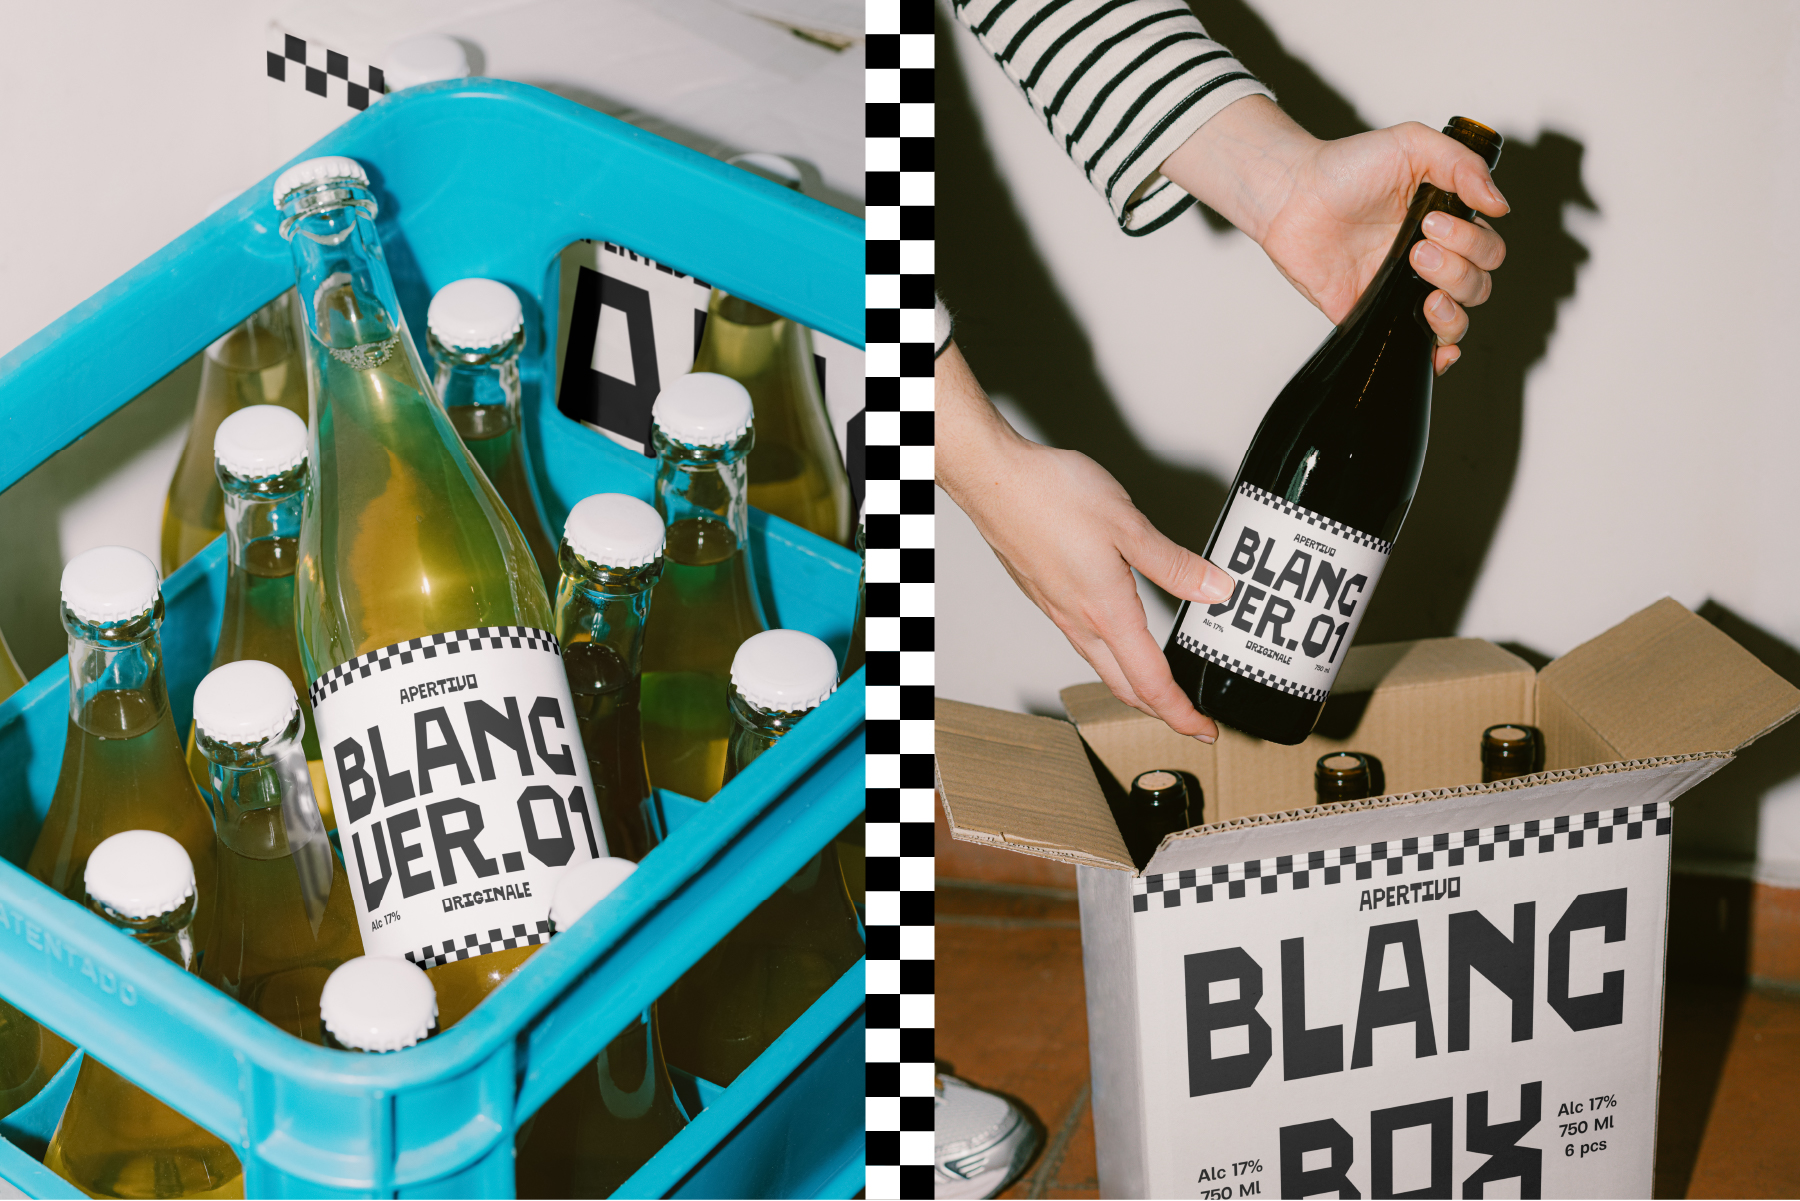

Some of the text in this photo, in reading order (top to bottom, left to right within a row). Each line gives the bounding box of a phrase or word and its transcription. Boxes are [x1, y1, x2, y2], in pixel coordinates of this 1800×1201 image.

[1293, 533, 1337, 558] APERTIVO
[1227, 526, 1368, 618] BLANC
[1202, 618, 1225, 633] Alc 17%
[1245, 640, 1293, 666] ORIGINALE
[399, 673, 479, 704] APERTIVO
[333, 695, 577, 825] BLANC
[351, 784, 600, 913] VER.01
[442, 881, 532, 913] ORIGINALE
[1358, 875, 1461, 912] APERTIVO
[371, 910, 401, 932] Alc 17%
[1183, 887, 1628, 1098] BLANC
[1557, 1093, 1617, 1117] Alc 17%
[1559, 1115, 1614, 1138] 750 Ml
[1279, 1080, 1543, 1200] BOX
[1565, 1140, 1607, 1158] 6 pcs
[1197, 1159, 1263, 1184] Alc 17%
[1200, 1180, 1261, 1200] 750 Ml
